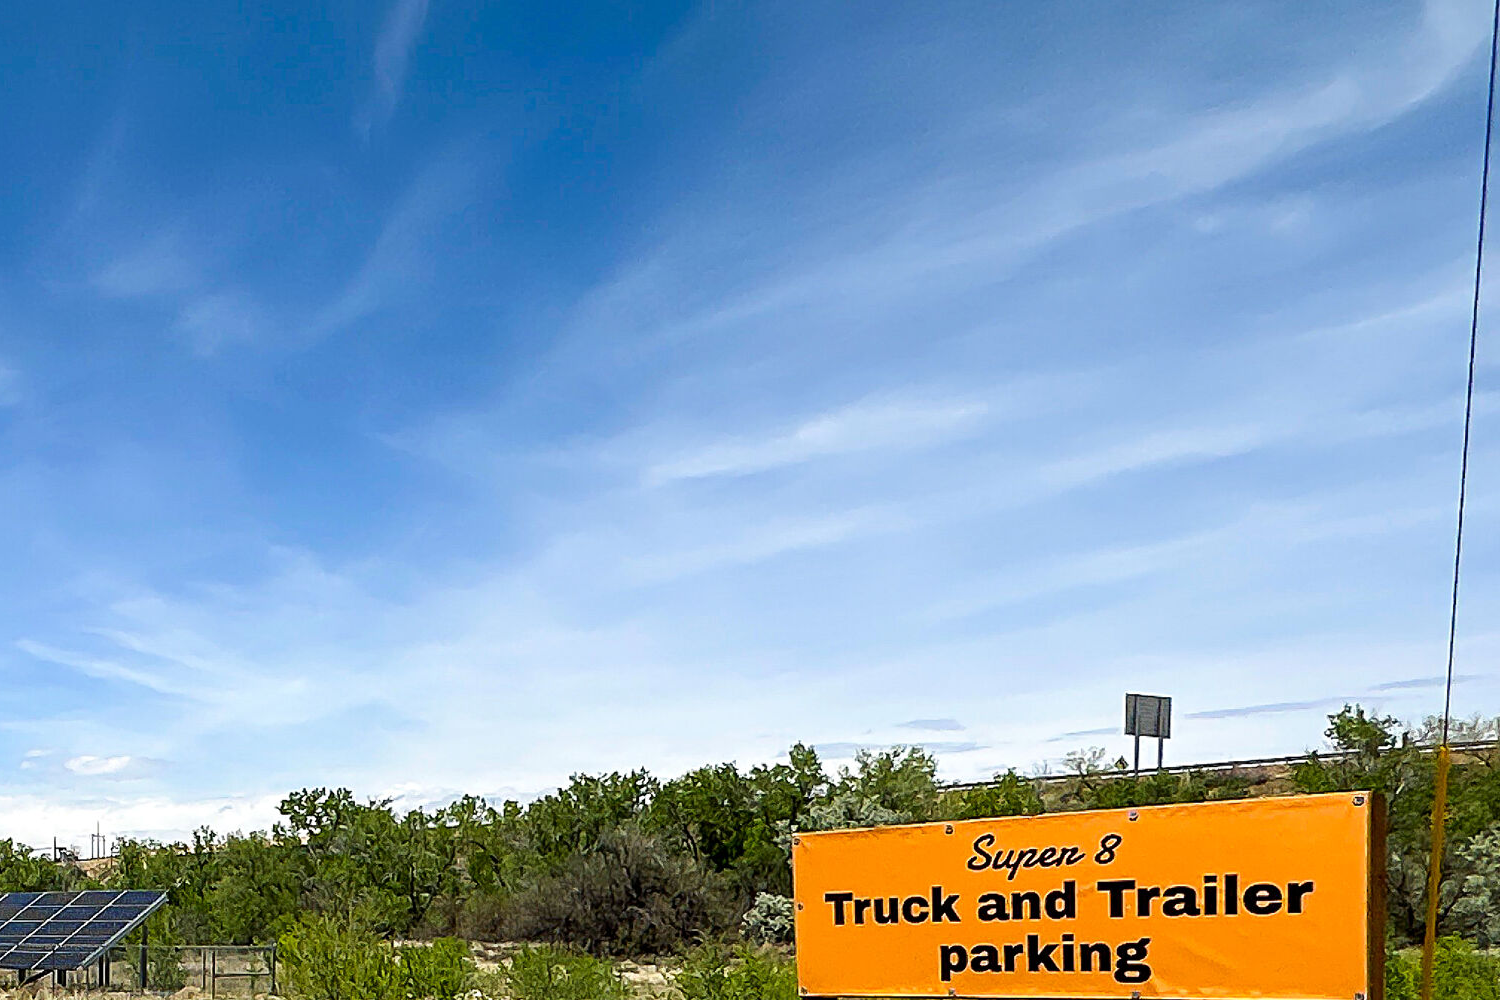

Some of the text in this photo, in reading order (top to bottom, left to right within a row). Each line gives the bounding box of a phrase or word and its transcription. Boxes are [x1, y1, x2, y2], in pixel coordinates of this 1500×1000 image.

[967, 833, 1122, 881] Super 8
[824, 873, 1314, 926] Truck and Trailer
[940, 933, 1152, 984] parking
